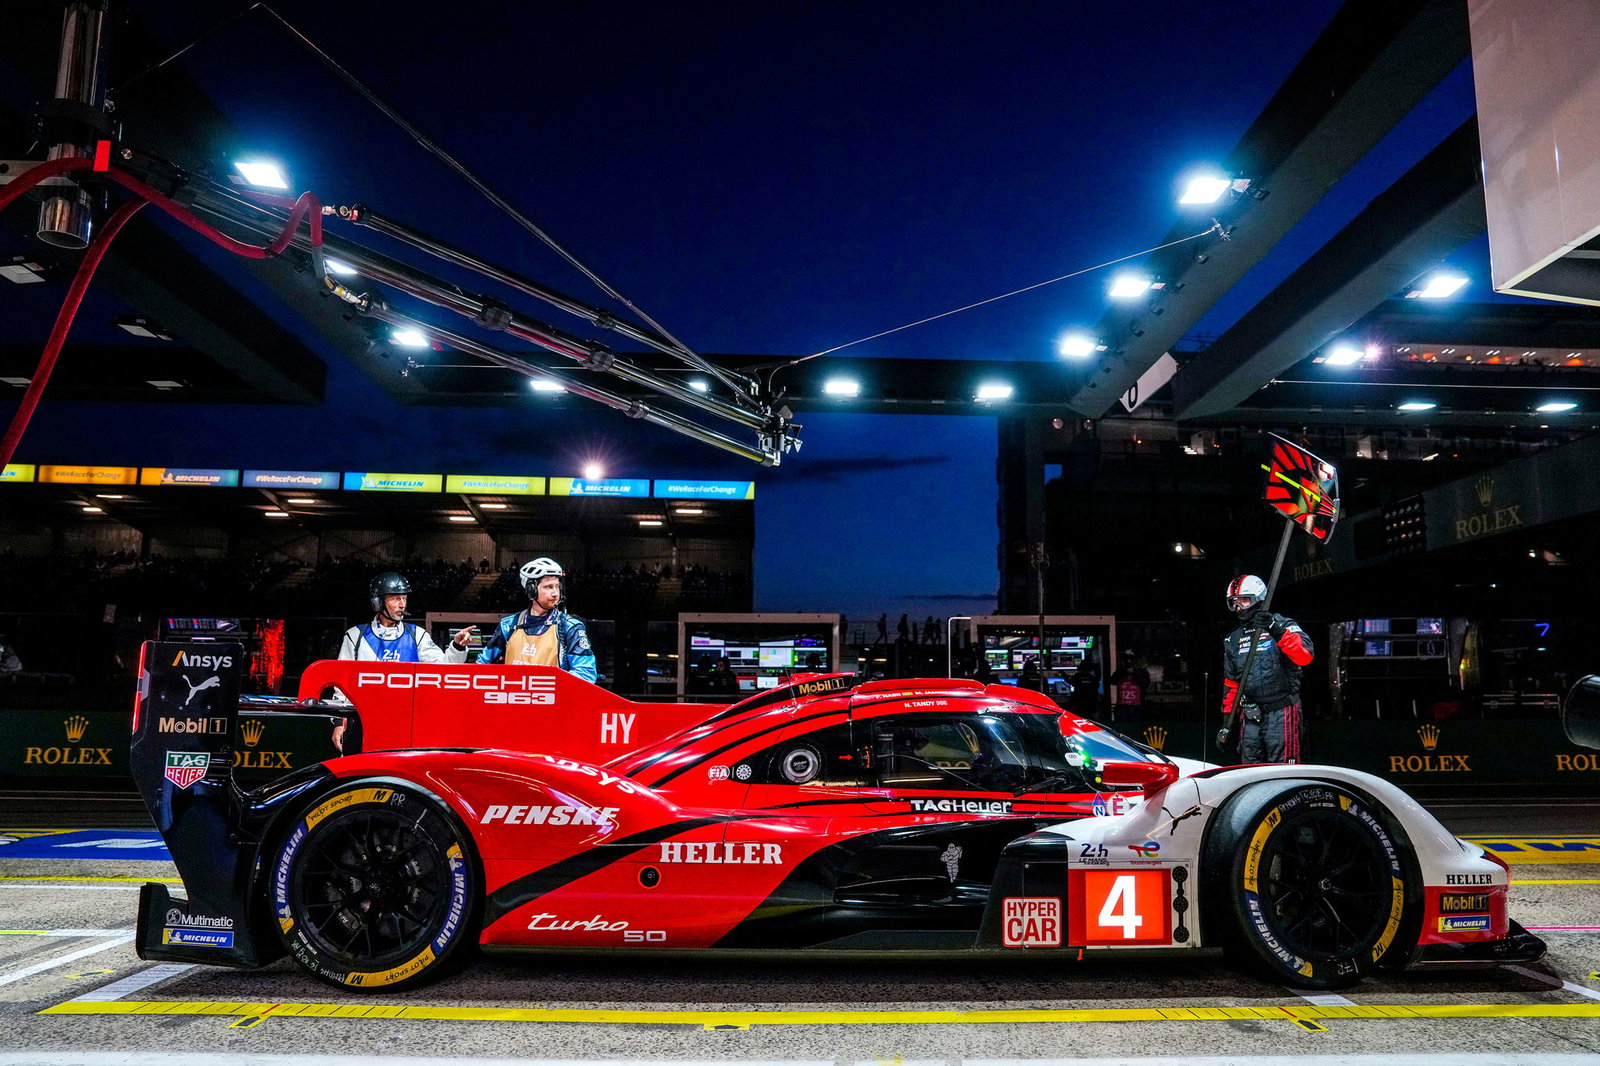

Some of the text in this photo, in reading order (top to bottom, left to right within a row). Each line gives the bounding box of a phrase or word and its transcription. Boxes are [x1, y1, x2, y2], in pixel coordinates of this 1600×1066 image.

[56, 471, 121, 480] #WeRaceForChange
[256, 475, 323, 485] #WeRaceForChange
[462, 481, 530, 489] #WeRaceForChange
[668, 485, 737, 495] #WeRaceForChange
[1456, 505, 1523, 541] ROLEX
[172, 651, 232, 671] Ansys
[358, 673, 556, 691] PORSCHE
[799, 680, 832, 694] Mobil
[484, 692, 555, 705] 963
[159, 718, 207, 733] Mobil
[600, 712, 636, 744] HY
[24, 747, 112, 765] ROLEX
[171, 754, 206, 766] TAG
[1389, 755, 1472, 772] ROLEX
[168, 768, 204, 786] HEUER
[709, 768, 727, 778] FIA
[310, 791, 386, 821] PILOT SPORT M
[1095, 807, 1104, 816] N
[1112, 798, 1124, 816] E
[480, 805, 620, 826] PENSKE
[1360, 811, 1400, 871] MICHELIN
[660, 842, 783, 865] HELLER
[1080, 843, 1109, 858] 24h
[276, 828, 304, 903] MICHELIN
[1446, 874, 1492, 885] HELLER
[436, 873, 464, 948] MICHELIN
[1007, 902, 1056, 916] HYPER
[1098, 875, 1142, 938] 4
[1443, 896, 1474, 910] Mobil
[181, 914, 234, 927] Multimatic
[527, 912, 629, 931] turbo
[1452, 919, 1487, 928] MICHELIN
[623, 930, 667, 942] 50
[1007, 918, 1056, 942] CAR
[1249, 900, 1293, 963] MICHELIN
[183, 934, 228, 943] MICHELIN
